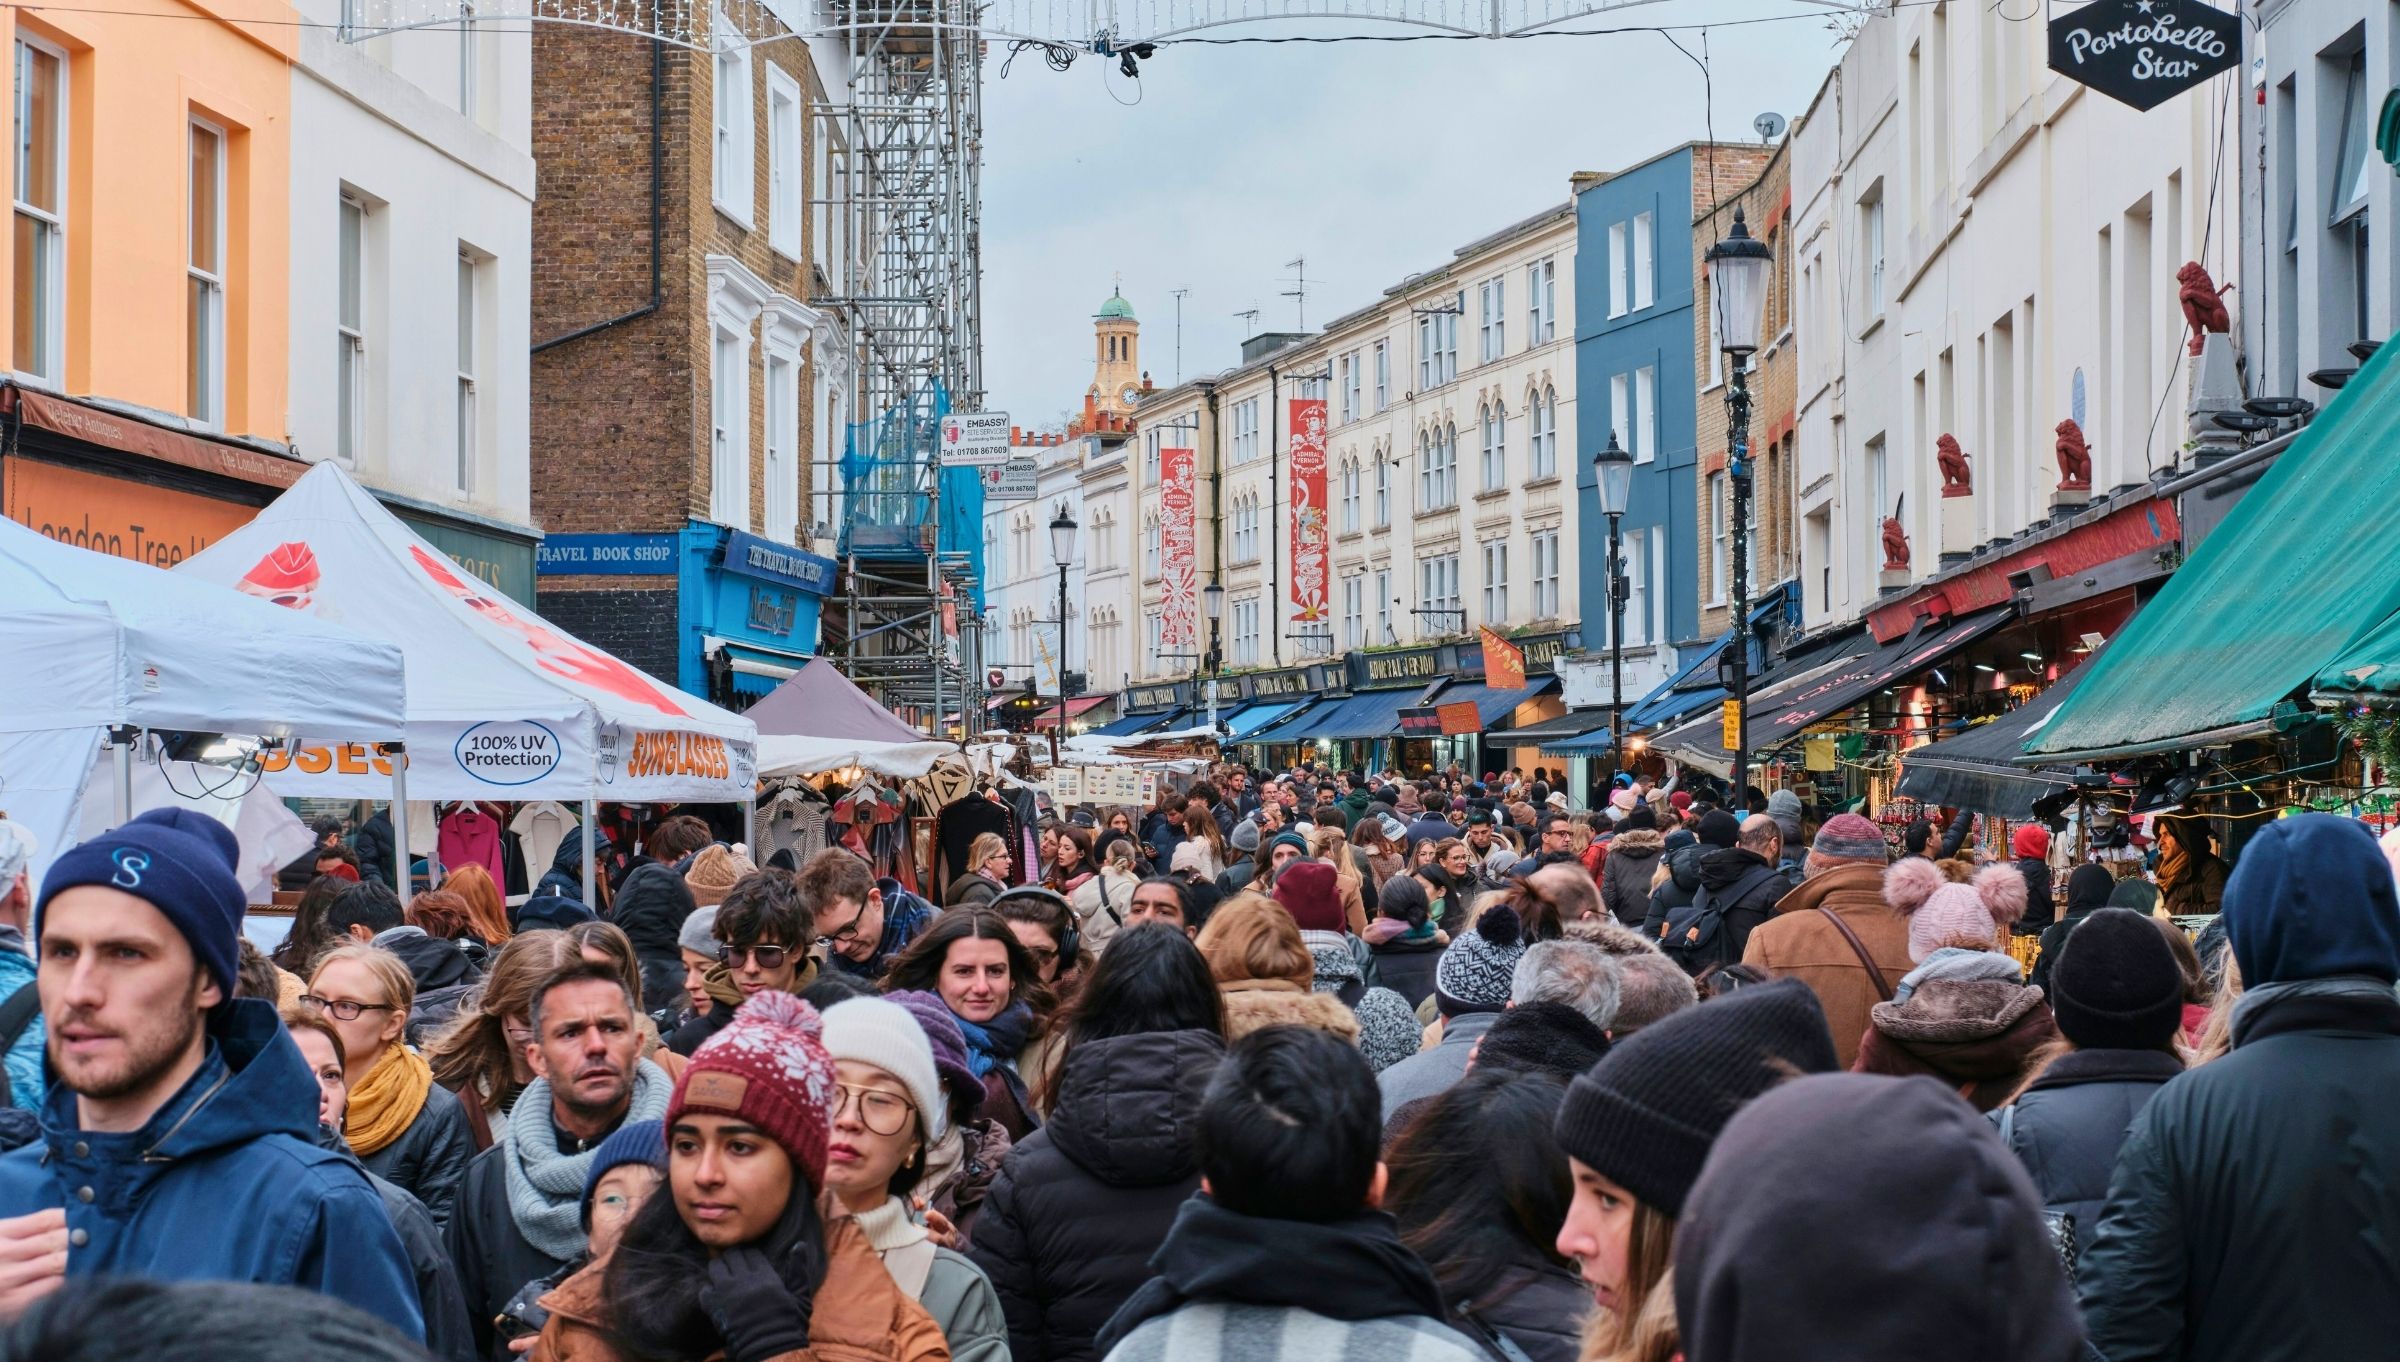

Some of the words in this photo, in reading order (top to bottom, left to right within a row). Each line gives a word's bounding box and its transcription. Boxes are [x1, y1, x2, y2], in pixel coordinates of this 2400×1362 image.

[2066, 14, 2225, 64] Portobello
[2132, 47, 2199, 80] Star
[85, 417, 122, 440] Antiques
[967, 418, 1007, 428] EMBASSY
[943, 449, 955, 457] Tel:
[957, 448, 979, 456] 01708
[981, 446, 1007, 455] 867609
[219, 449, 235, 468] The
[236, 453, 264, 474] London
[264, 460, 282, 478] Tree
[536, 547, 587, 562] TRAVEL
[593, 546, 631, 561] BOOK
[634, 546, 670, 561] SHOP
[748, 544, 762, 566] THE
[762, 549, 787, 575] TRAVEL
[787, 556, 806, 579] BOOK
[805, 562, 823, 583] SHOP
[471, 736, 517, 750] 100%
[520, 735, 546, 750] UV
[465, 752, 552, 766] Protection
[628, 730, 729, 780] SUNGLASSES
